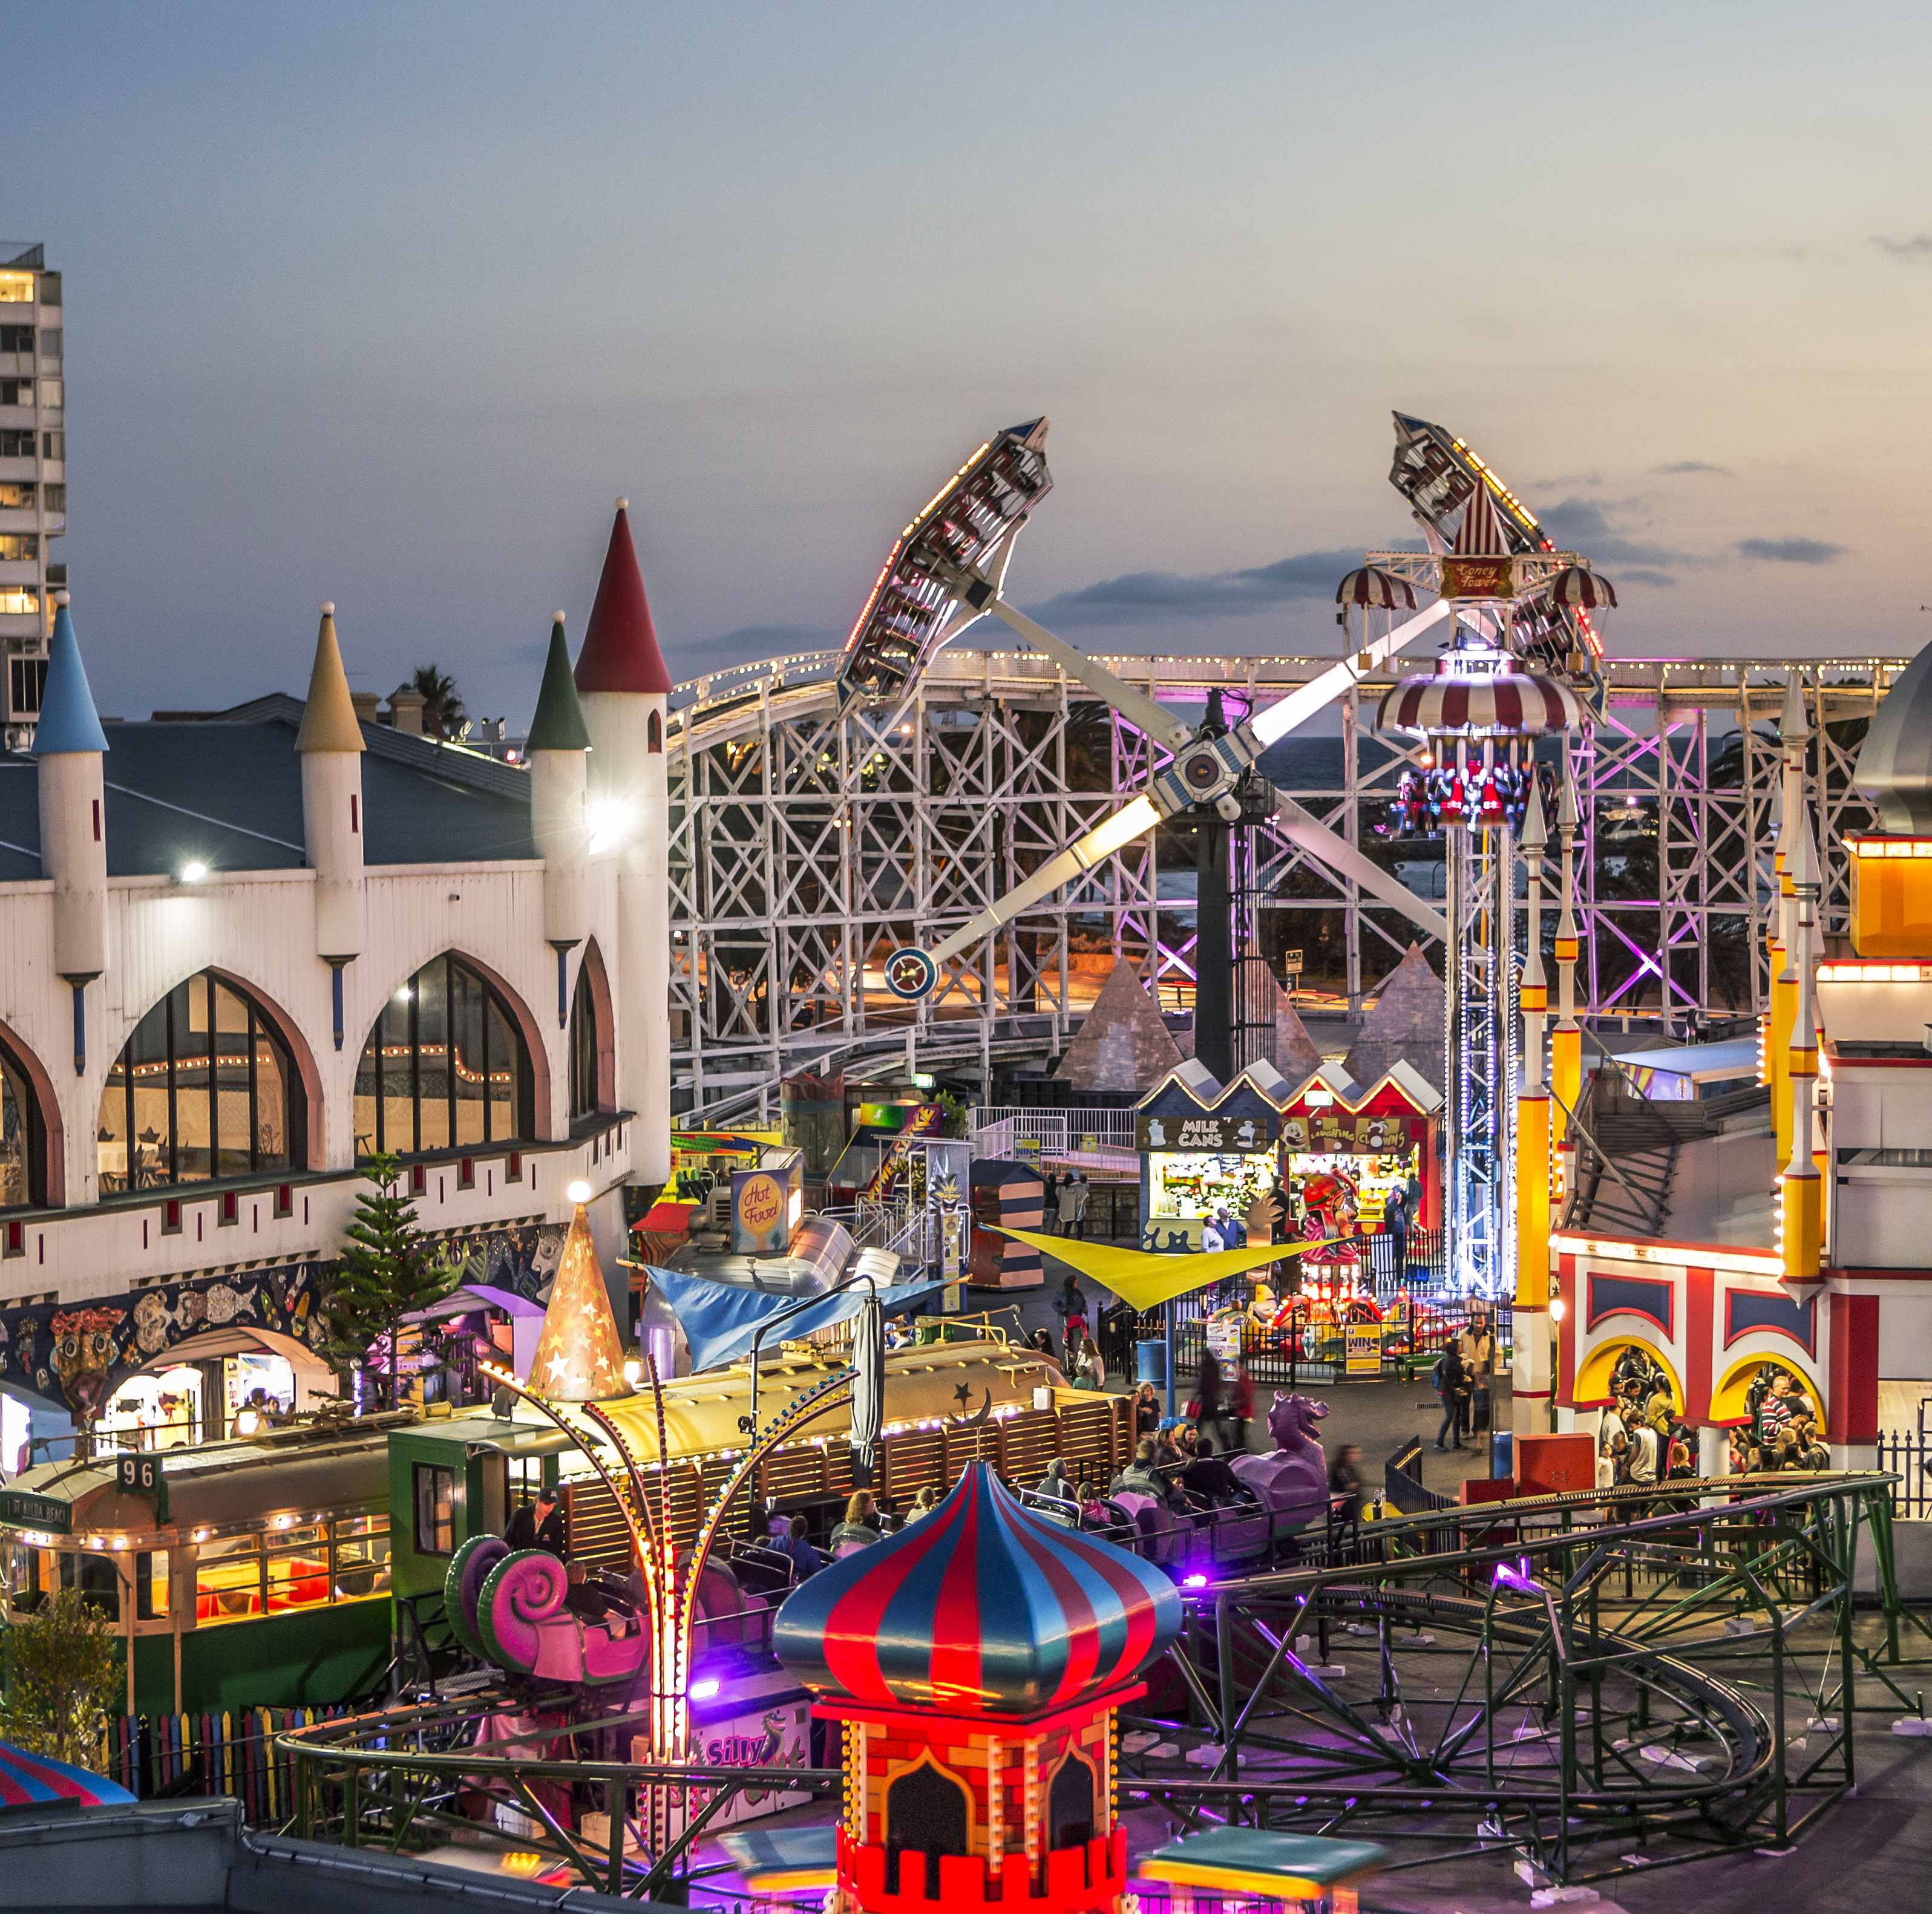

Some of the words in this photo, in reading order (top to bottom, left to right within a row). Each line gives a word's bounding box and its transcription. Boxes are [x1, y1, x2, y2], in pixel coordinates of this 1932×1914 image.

[1456, 564, 1497, 578] Coney
[1461, 575, 1498, 587] Tower
[1182, 1119, 1219, 1133] MILK
[1178, 1133, 1223, 1147] CANS
[1311, 1128, 1355, 1142] LAUGHING
[1358, 1131, 1405, 1149] CLOWNS
[867, 1154, 898, 1201] POWE
[744, 1183, 770, 1206] Hot
[744, 1201, 778, 1224] Food
[1348, 1337, 1370, 1347] WIN
[124, 1460, 152, 1487] 96
[24, 1502, 43, 1519] KILDA
[707, 1736, 766, 1766] Silly
